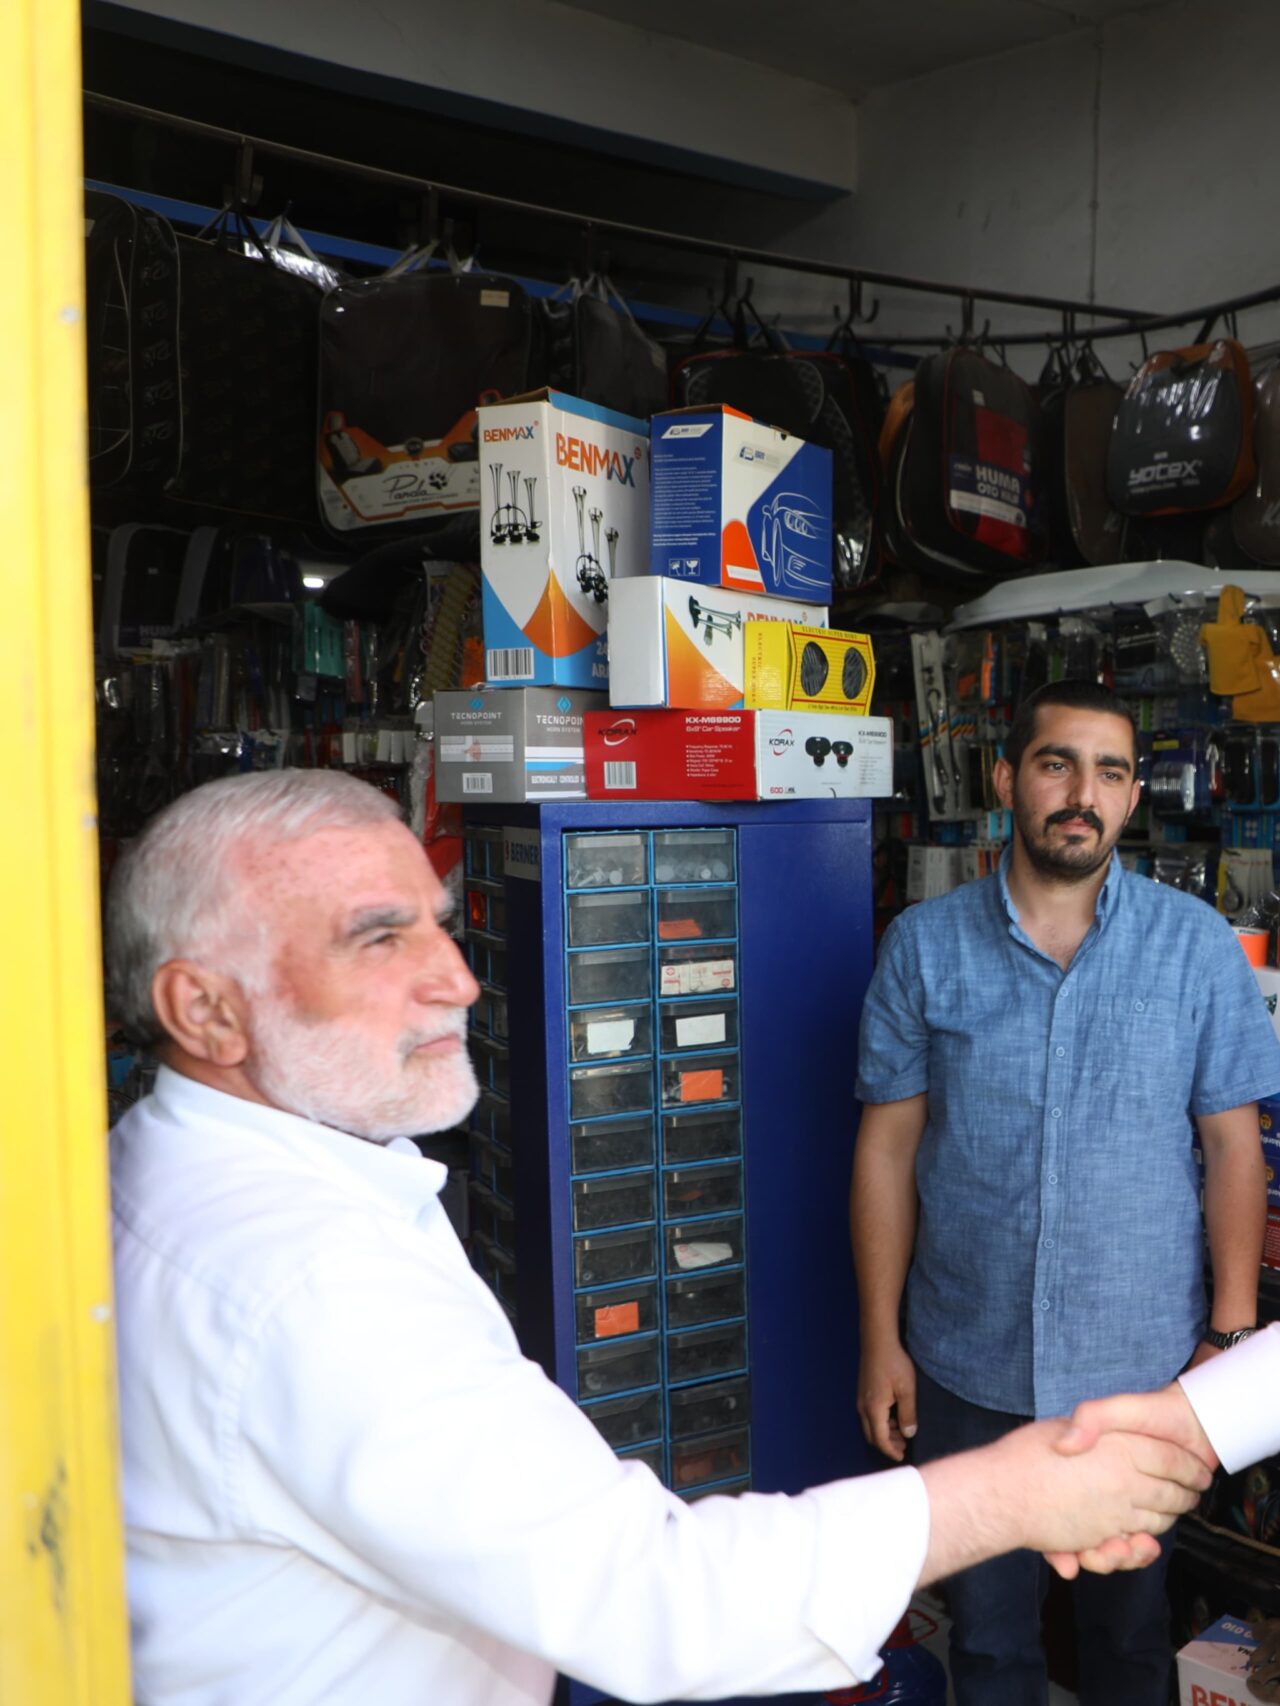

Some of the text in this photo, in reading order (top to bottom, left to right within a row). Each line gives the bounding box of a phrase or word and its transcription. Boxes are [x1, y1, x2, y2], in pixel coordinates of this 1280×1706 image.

[484, 426, 534, 443] BENMAX
[556, 432, 635, 488] BENMAX
[383, 474, 428, 499] Panda
[451, 712, 502, 720] TECNOPOINT
[536, 715, 584, 726] TECNOPOIN
[769, 738, 794, 747] KORAX
